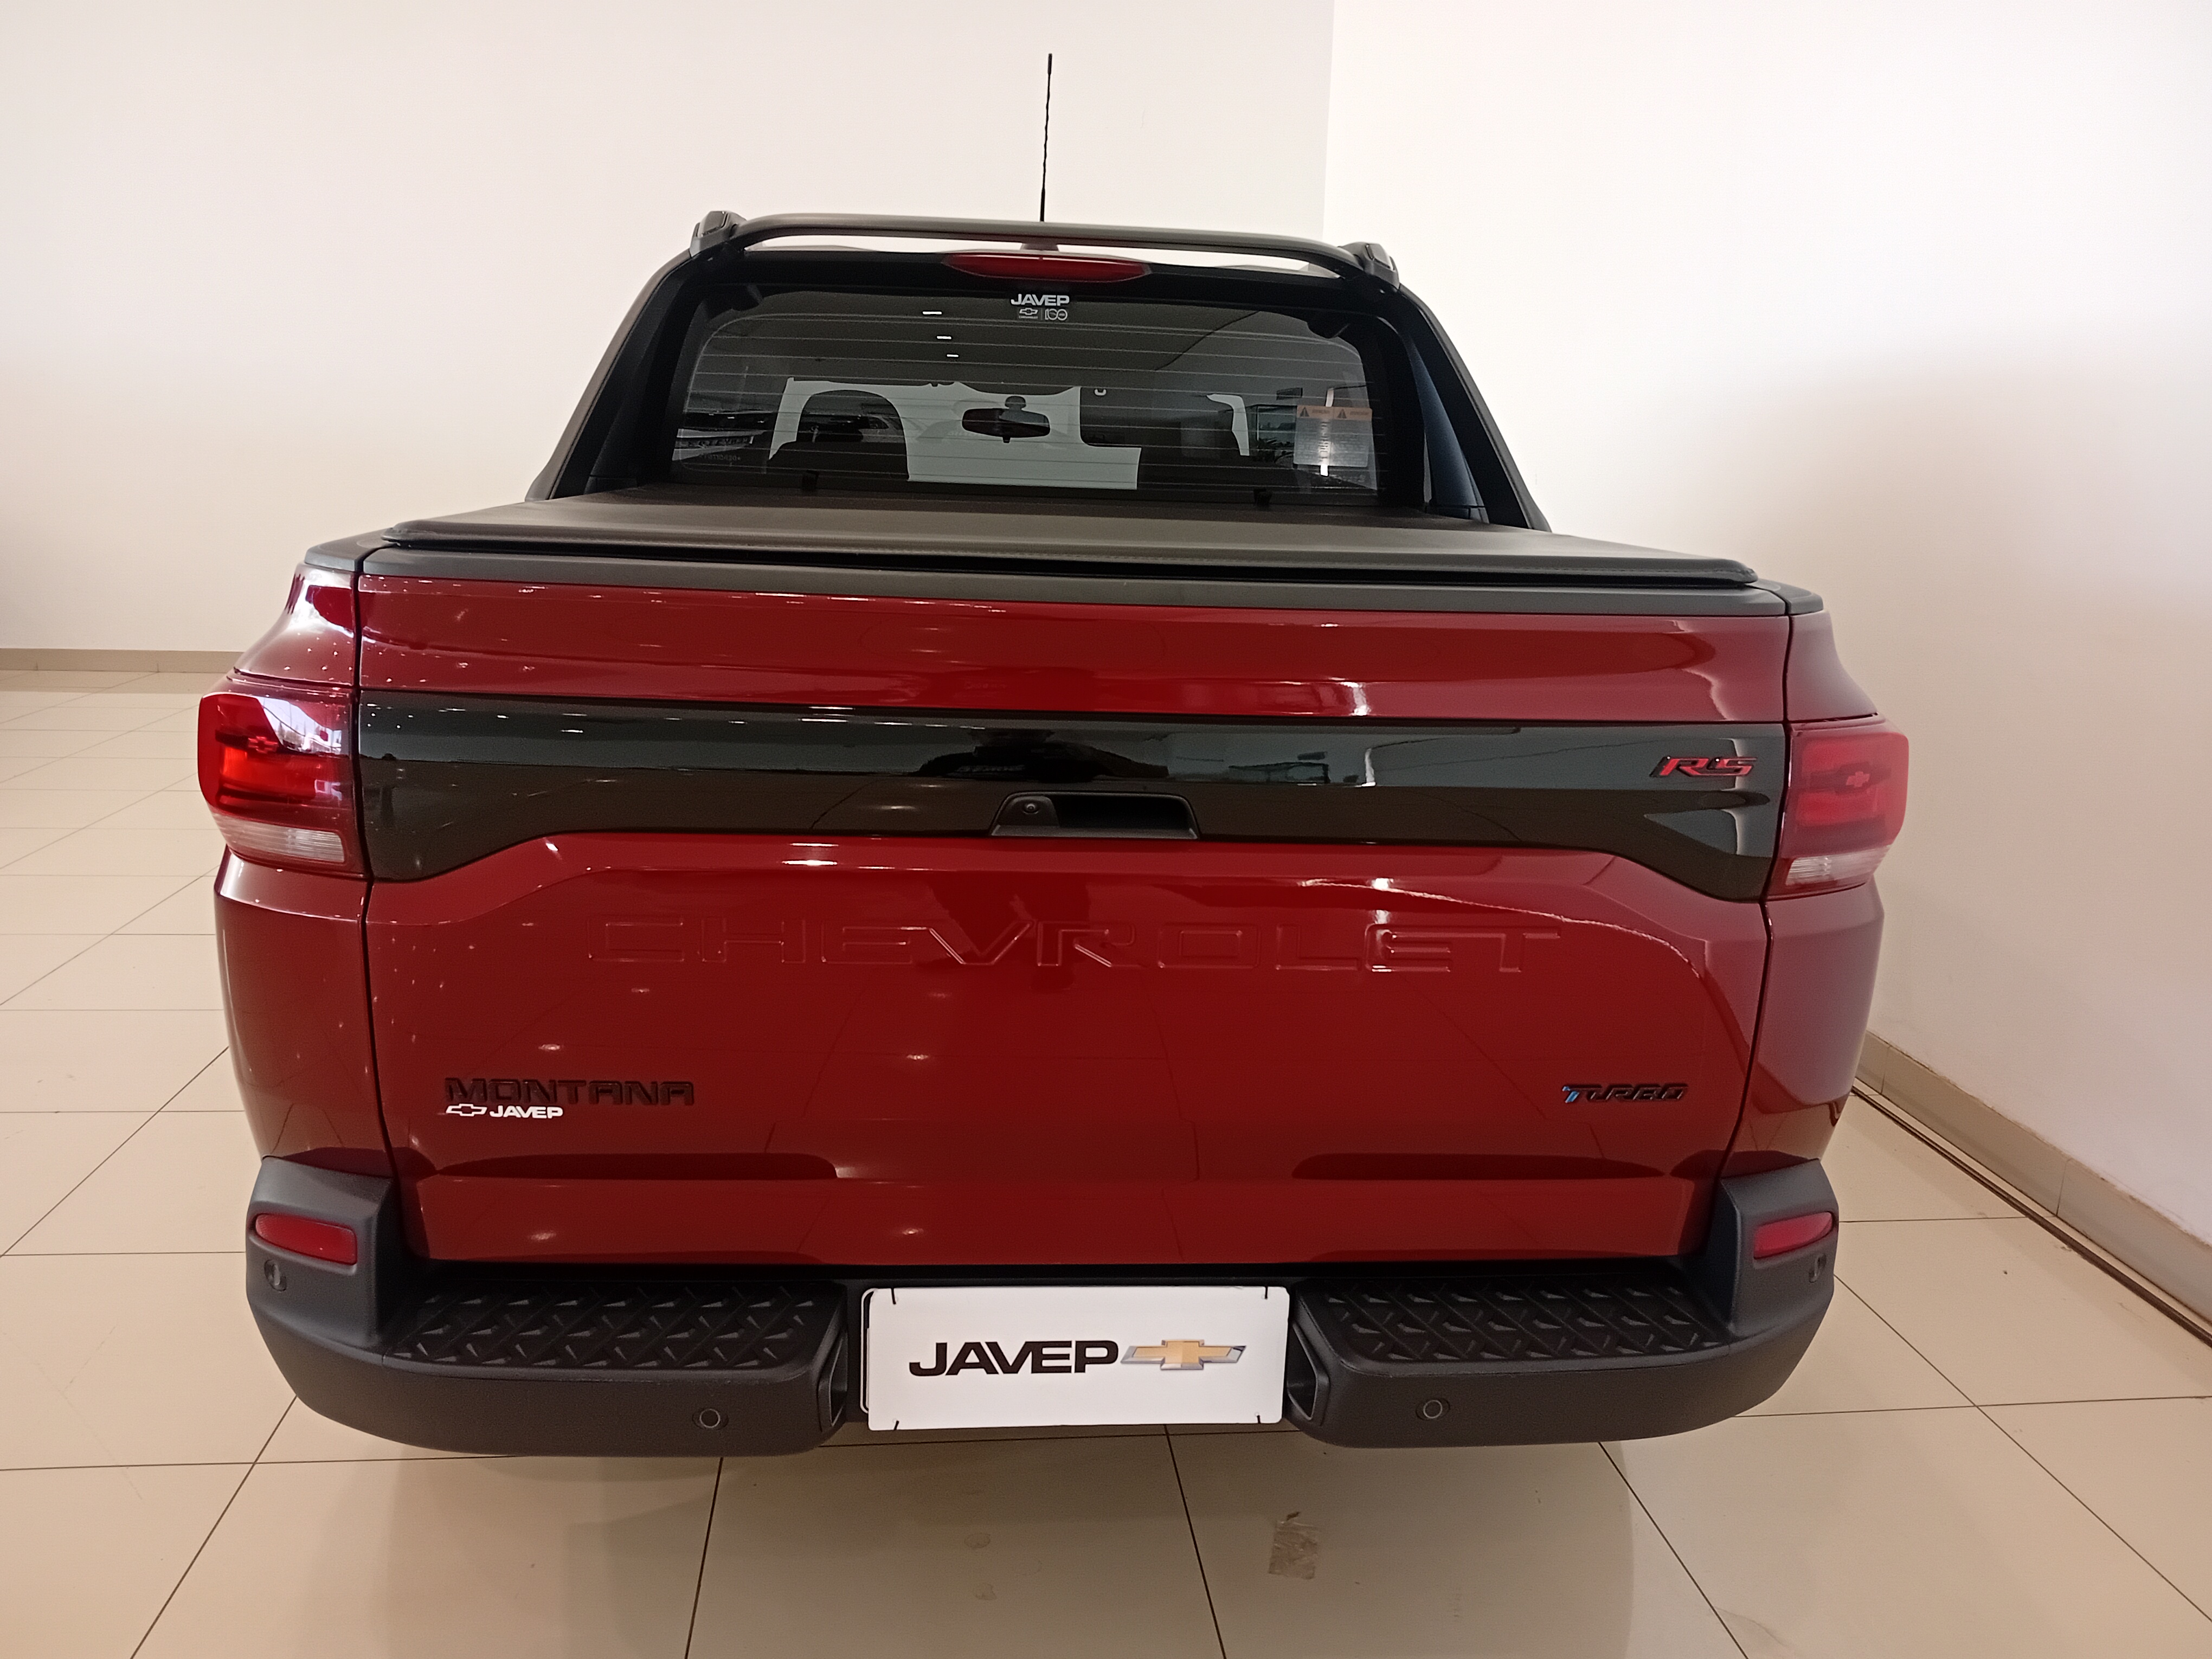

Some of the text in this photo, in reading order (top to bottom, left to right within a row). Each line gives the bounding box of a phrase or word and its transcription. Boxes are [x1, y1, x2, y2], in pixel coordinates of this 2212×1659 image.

[1010, 293, 1070, 306] JAVEP
[1650, 756, 1757, 777] RS
[587, 916, 1561, 973] CHEVROLET
[445, 1077, 695, 1105] MONTANA
[1562, 1083, 1688, 1103] TURBO
[489, 1105, 563, 1118] JAVEP
[909, 1340, 1119, 1377] JAVEP
